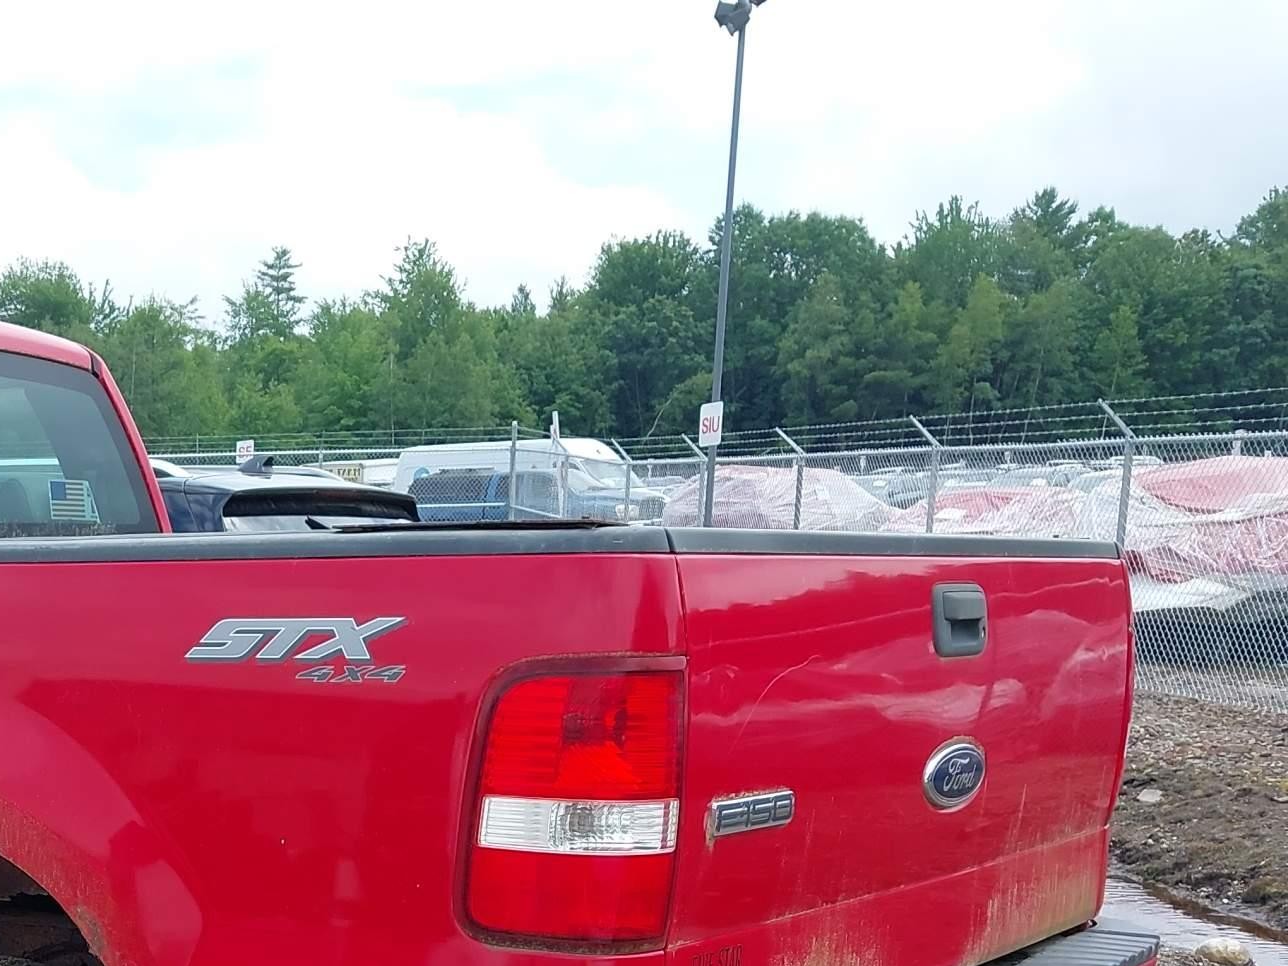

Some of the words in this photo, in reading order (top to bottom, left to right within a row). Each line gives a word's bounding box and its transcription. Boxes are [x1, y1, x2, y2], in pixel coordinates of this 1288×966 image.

[701, 416, 720, 434] SIU
[184, 616, 408, 663] STX
[943, 757, 977, 792] Ford
